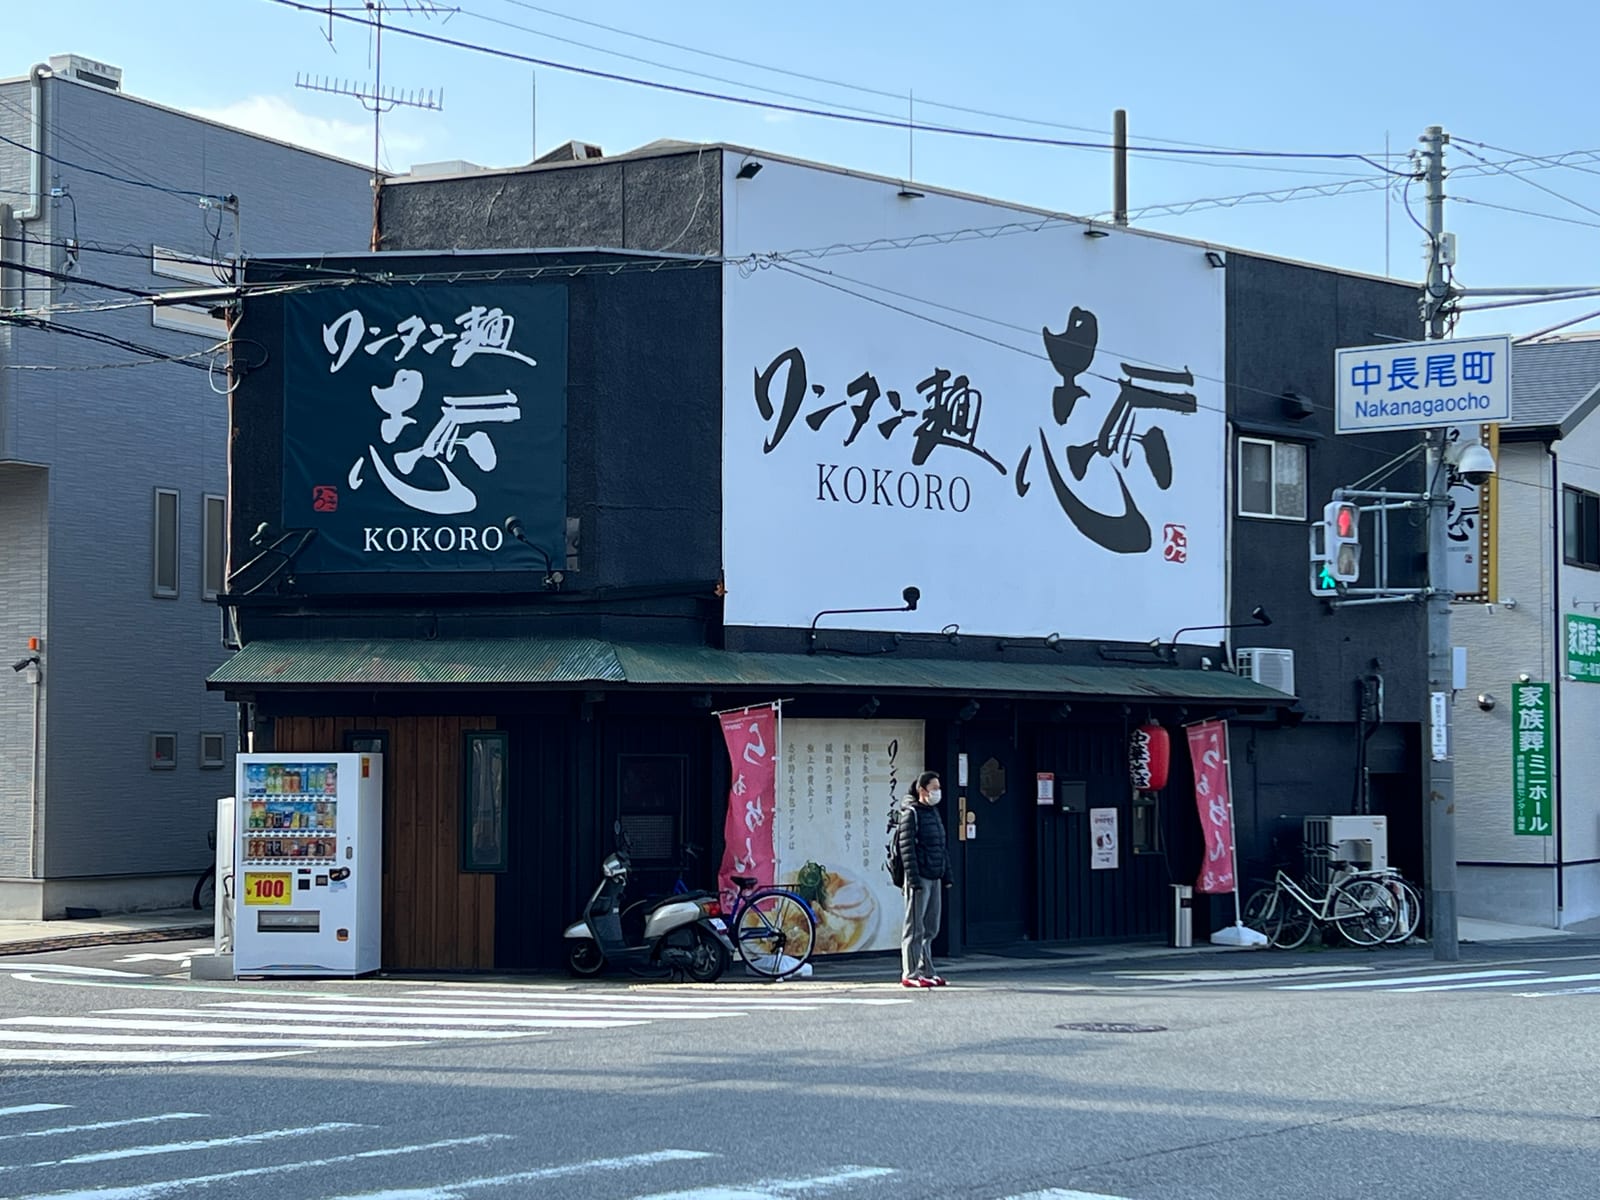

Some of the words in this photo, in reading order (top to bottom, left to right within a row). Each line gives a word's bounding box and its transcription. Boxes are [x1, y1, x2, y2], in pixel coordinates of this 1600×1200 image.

[323, 305, 537, 373] ワンタン麺
[1351, 351, 1496, 395] 中長尾町
[754, 347, 1007, 475] ワンタン麺
[1355, 393, 1490, 418] Nakanagaocho
[816, 463, 971, 513] KOKORO
[363, 526, 504, 553] KOKORO
